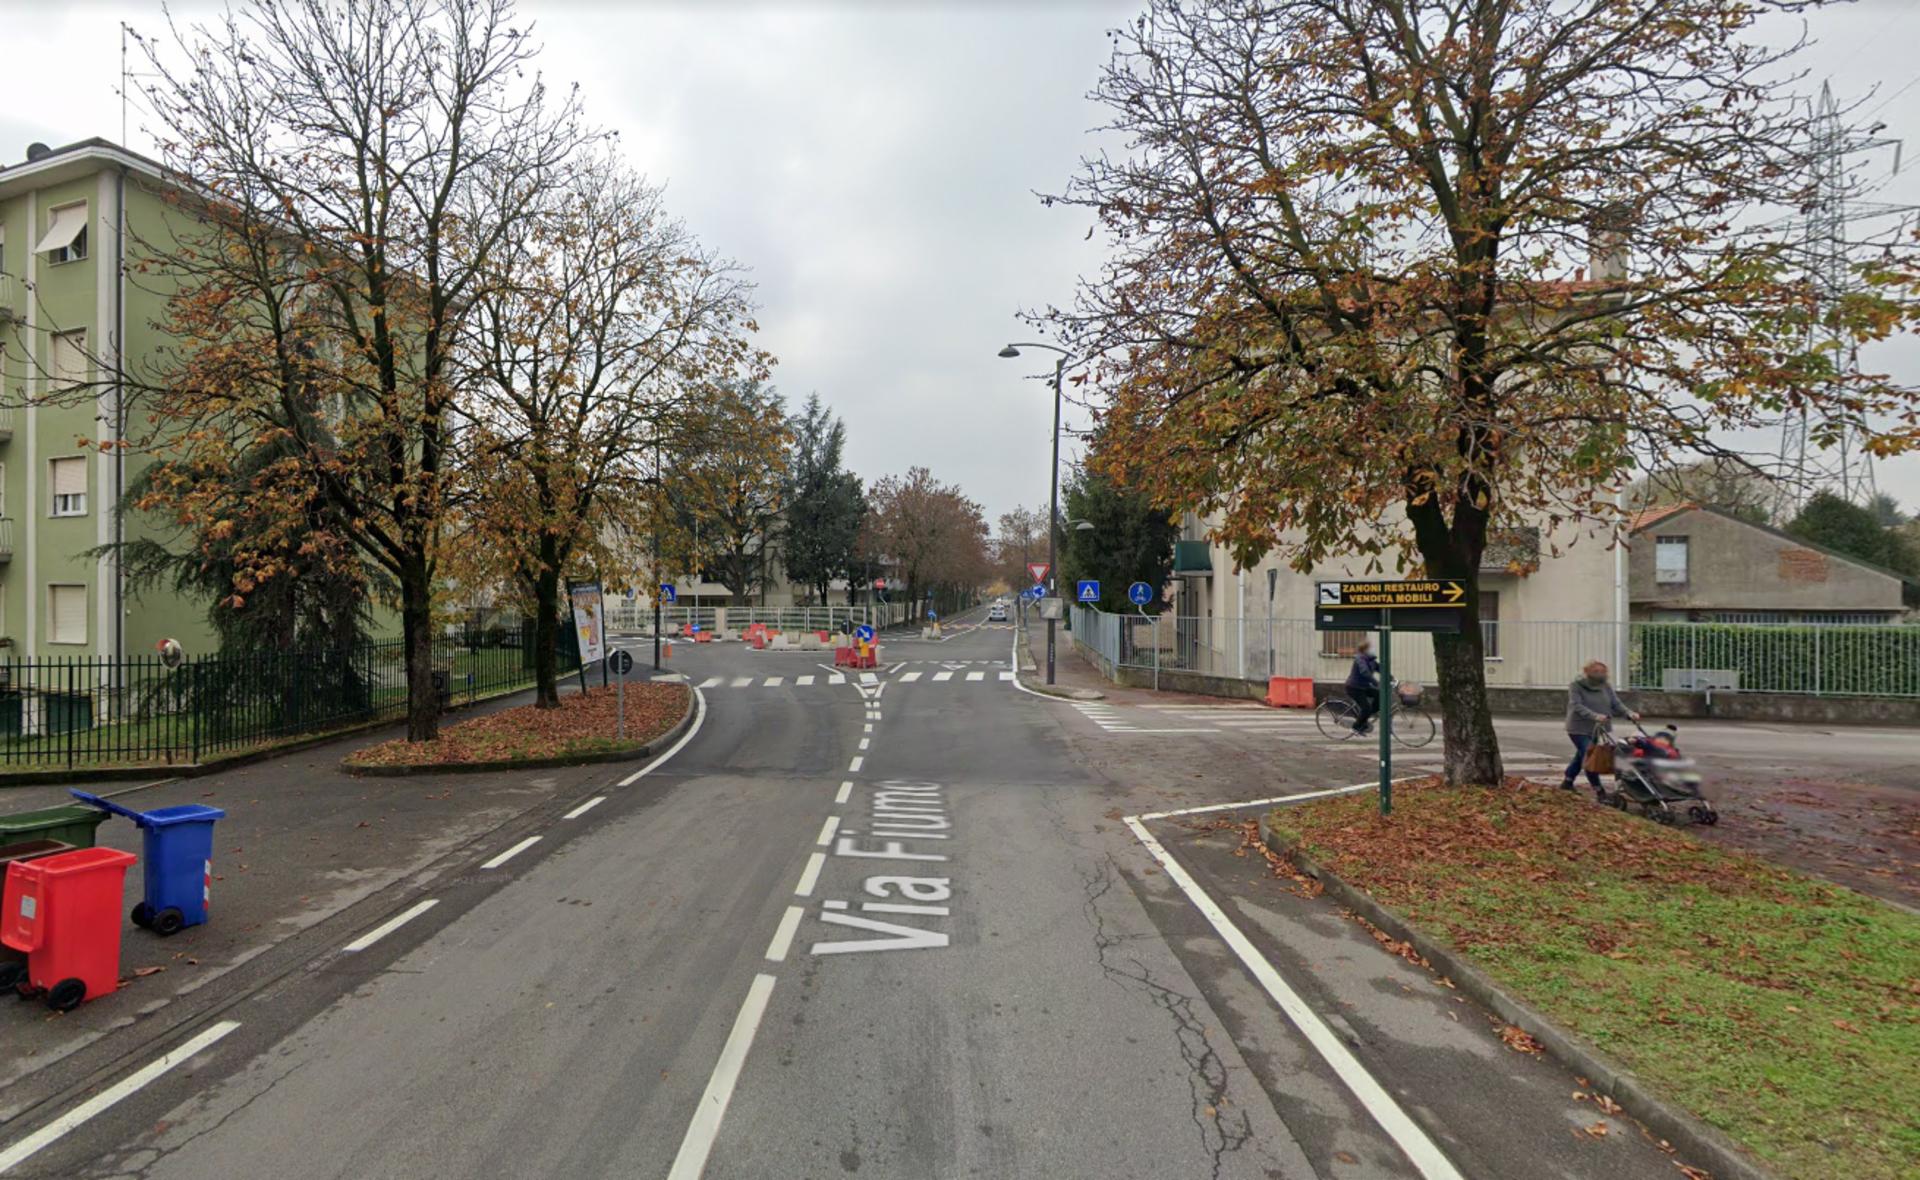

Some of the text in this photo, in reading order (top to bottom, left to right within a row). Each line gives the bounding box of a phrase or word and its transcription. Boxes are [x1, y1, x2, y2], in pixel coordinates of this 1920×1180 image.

[1342, 583, 1439, 593] ZANONI RESTAURO
[1350, 594, 1432, 603] VENDITA MOBILI
[811, 876, 949, 955] Via
